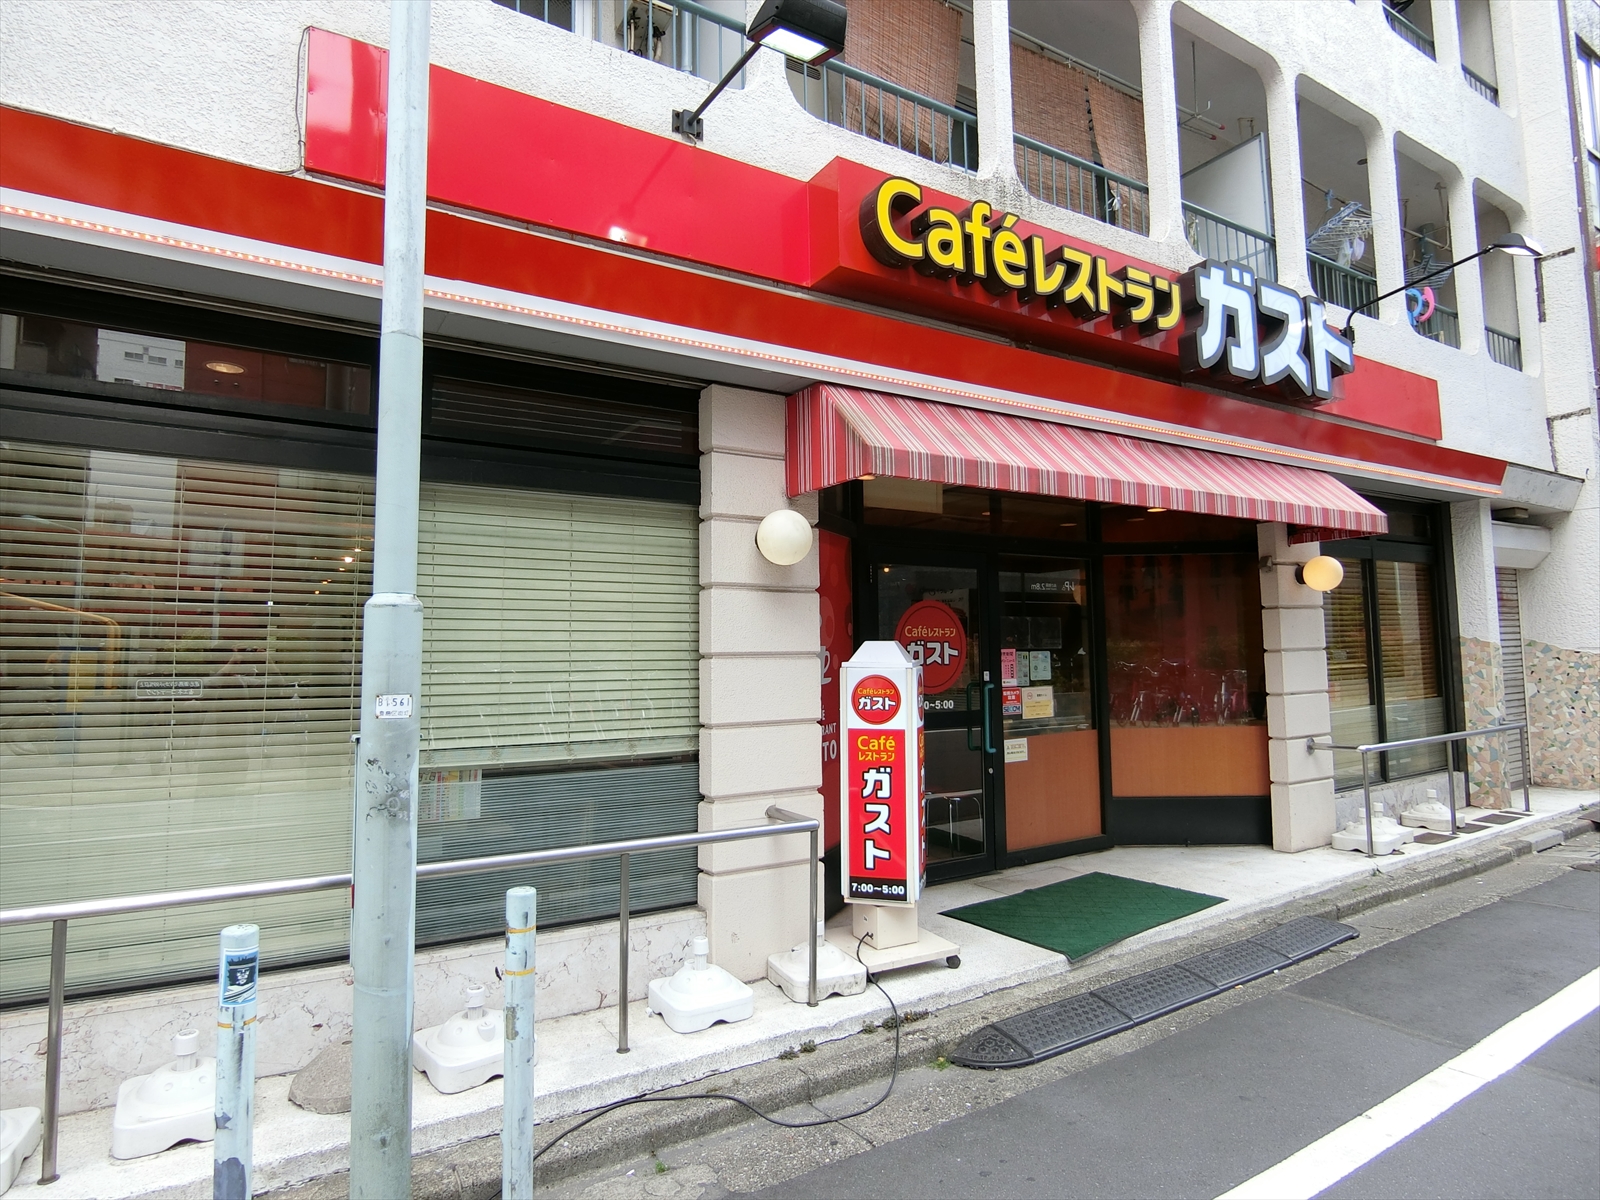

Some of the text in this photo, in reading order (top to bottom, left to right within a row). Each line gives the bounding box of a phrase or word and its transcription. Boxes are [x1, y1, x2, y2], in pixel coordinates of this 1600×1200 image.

[876, 178, 1354, 396] Caféレストラン ガスト
[904, 625, 956, 637] Caféレストラン
[906, 640, 959, 665] ガスト
[858, 696, 896, 710] ガスト
[857, 735, 895, 750] Café
[858, 751, 895, 761] レストラン
[862, 766, 892, 870] ガスト
